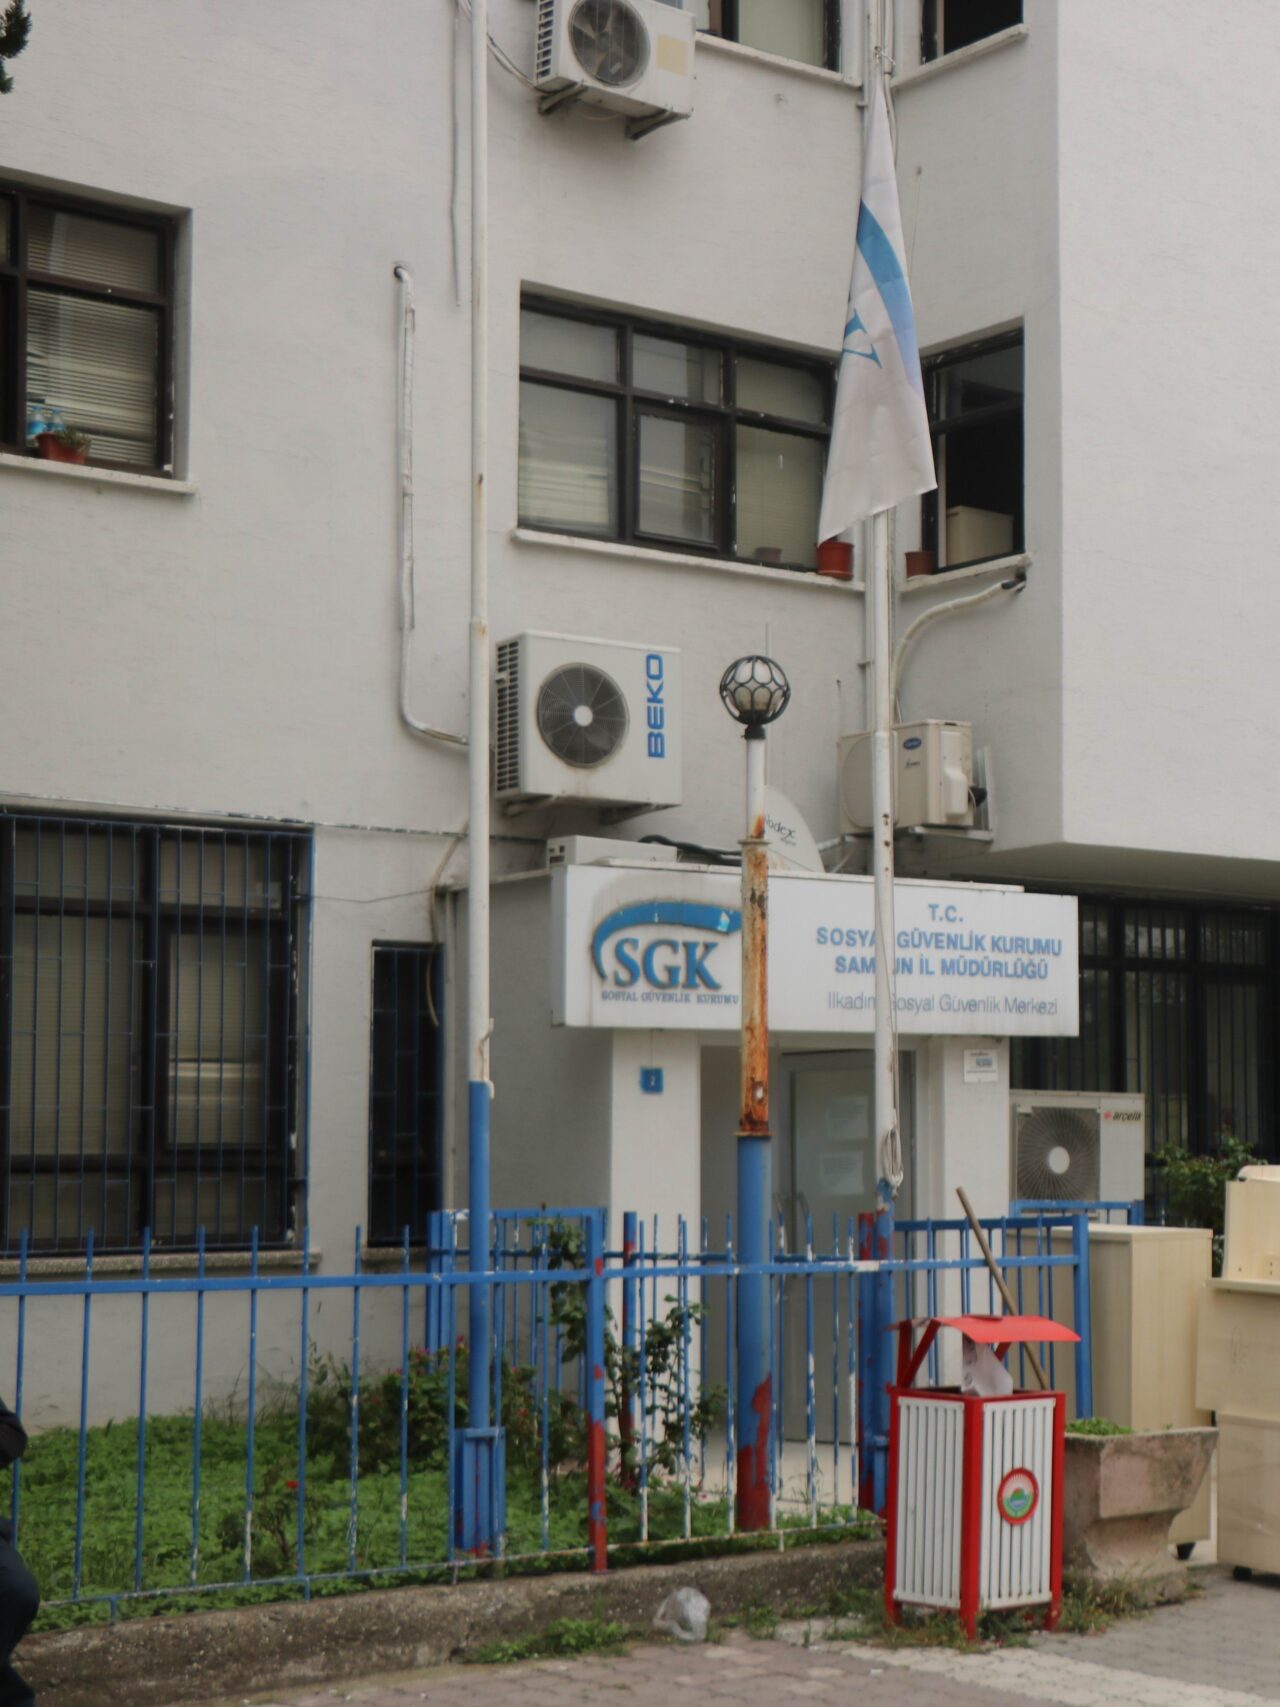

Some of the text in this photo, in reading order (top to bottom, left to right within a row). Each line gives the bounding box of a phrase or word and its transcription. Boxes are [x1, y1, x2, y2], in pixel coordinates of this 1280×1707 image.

[645, 653, 665, 759] BEKO
[928, 903, 964, 922] T.C.
[816, 926, 1063, 957] SOSYA GÜVENLİK KURUMU
[614, 937, 722, 991] SGK
[834, 953, 1049, 980] SAMN İL MÜDÜRLÜĞÜ
[602, 989, 739, 1005] SOSYAL GÜVENLİK KURUMU
[893, 993, 935, 1016] osyal
[939, 993, 1001, 1014] Güvenlik
[1004, 996, 1058, 1016] Merkezi
